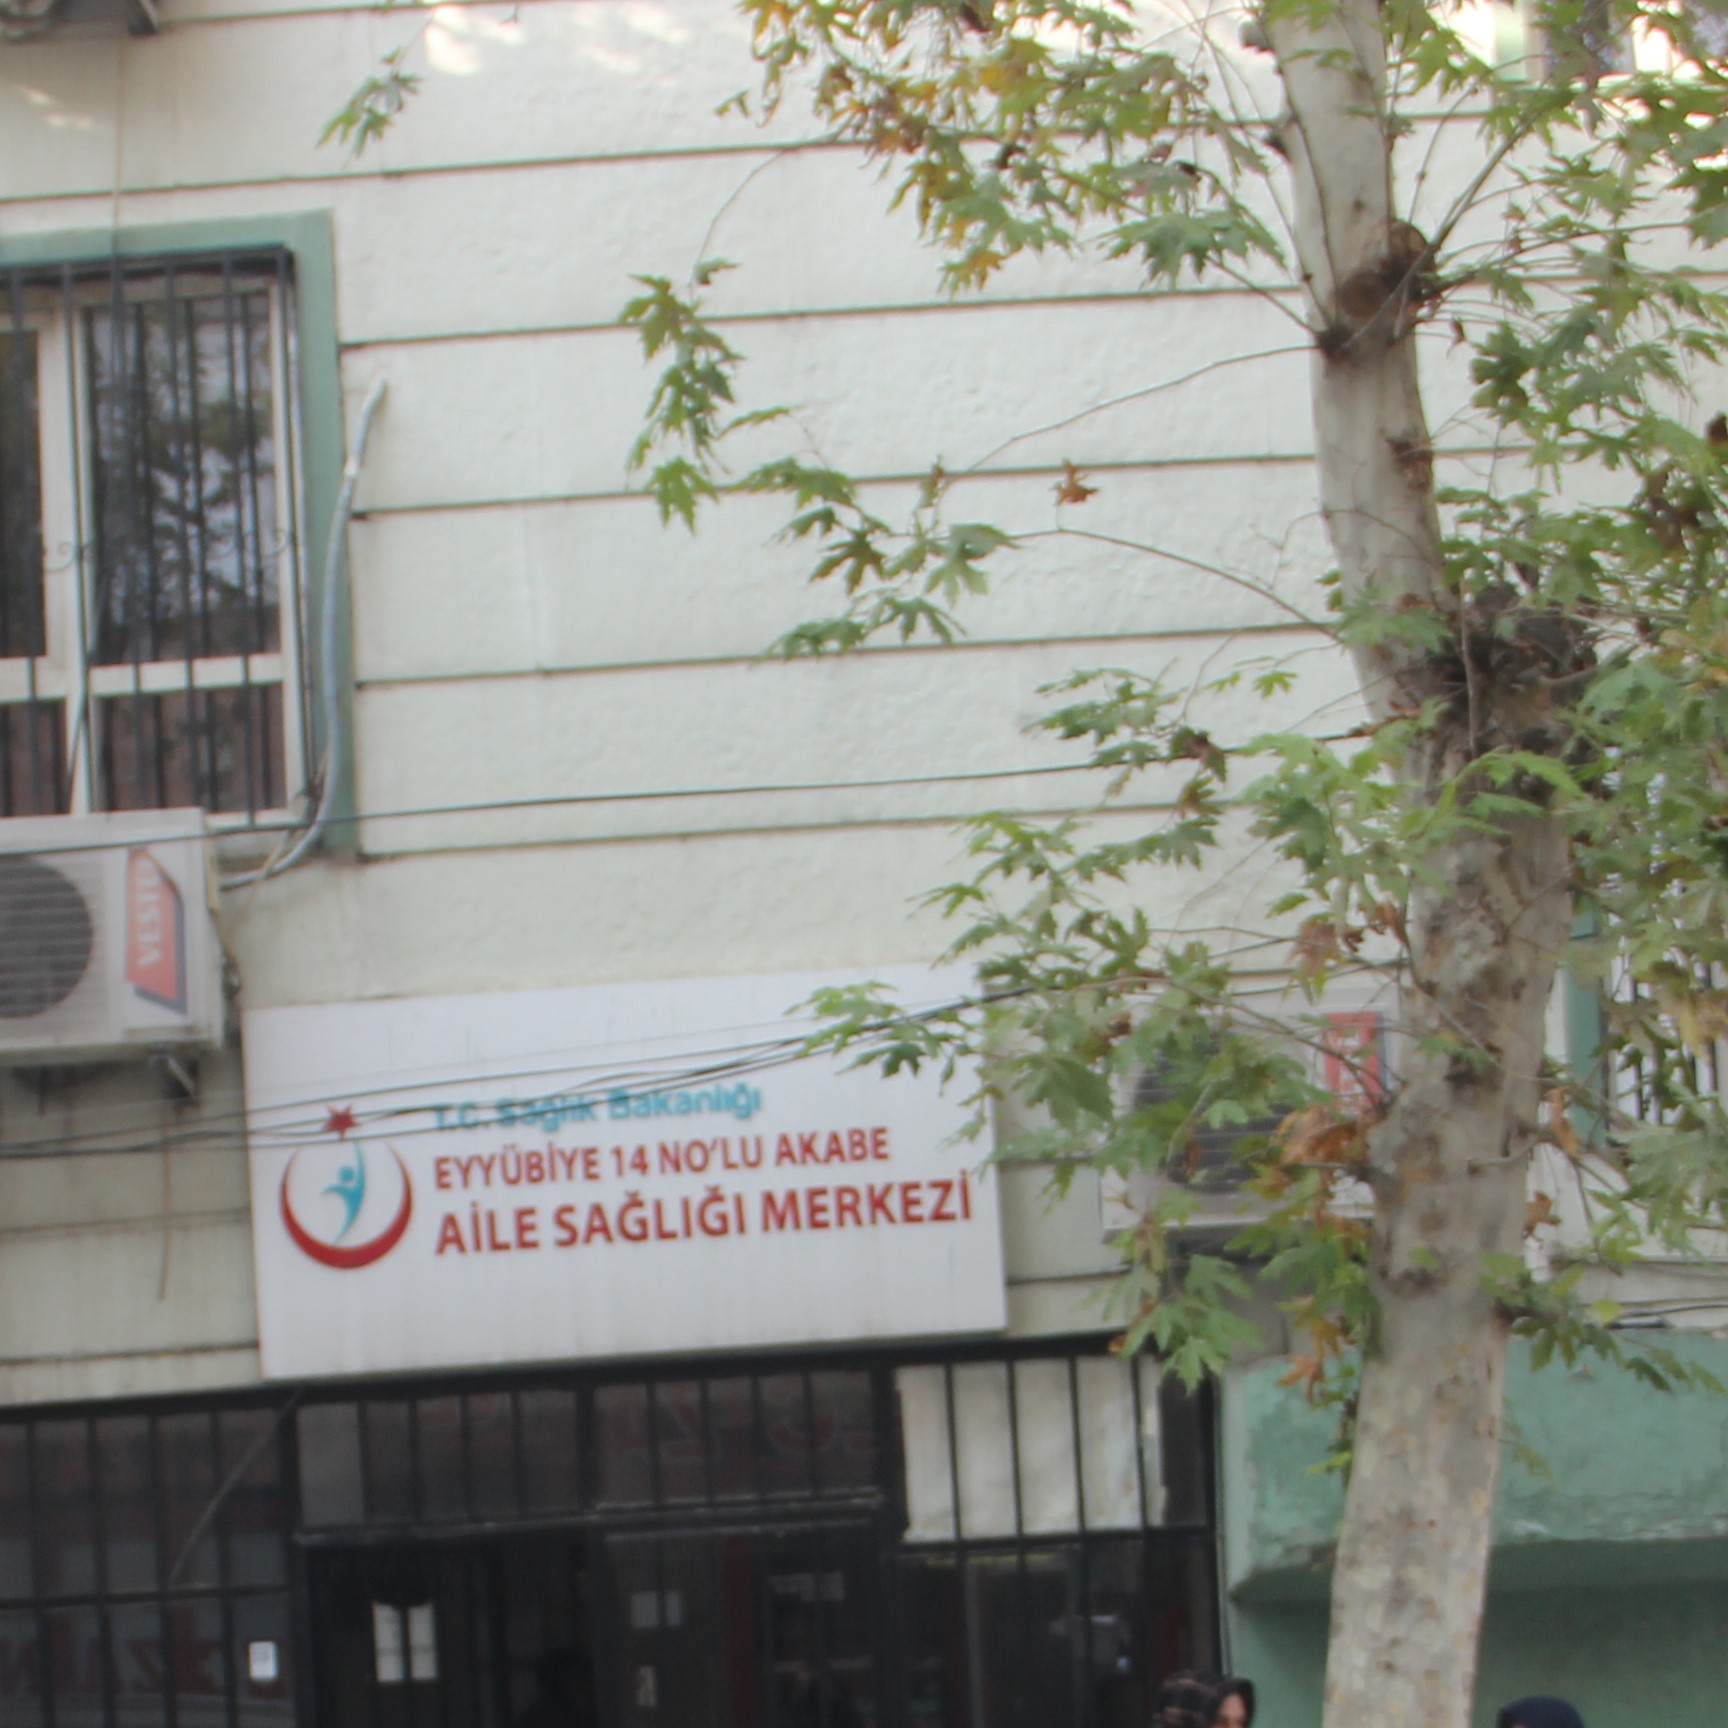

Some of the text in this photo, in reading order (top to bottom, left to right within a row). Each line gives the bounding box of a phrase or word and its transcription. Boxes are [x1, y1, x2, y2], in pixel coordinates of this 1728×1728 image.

[435, 1141, 601, 1191] EYYÜBİYE
[612, 1146, 650, 1176] 14
[776, 1127, 889, 1165] AKABE
[436, 1170, 973, 1256] AİLE SAĞLIĞI MERKEZİ
